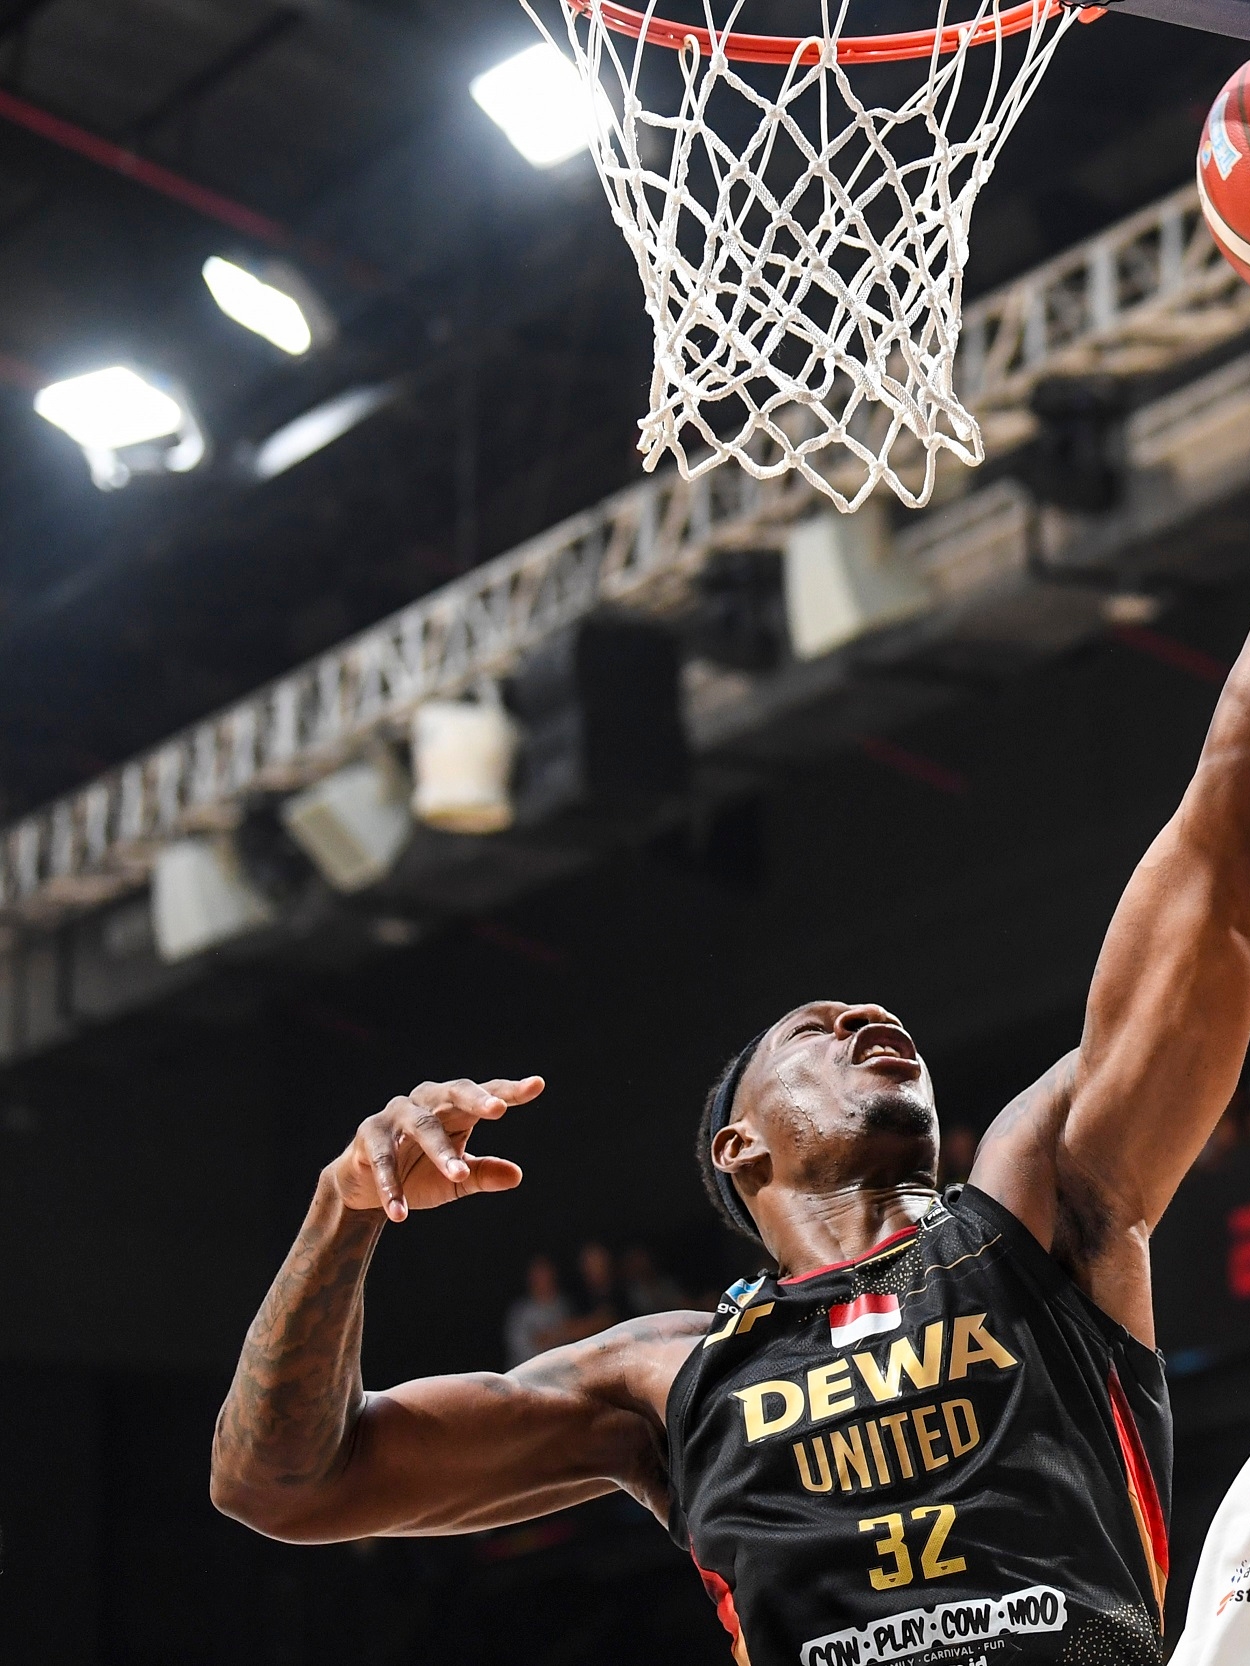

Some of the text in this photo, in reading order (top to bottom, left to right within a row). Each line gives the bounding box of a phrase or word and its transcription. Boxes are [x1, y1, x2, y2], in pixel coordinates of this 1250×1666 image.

[733, 1312, 1019, 1443] DEWA
[793, 1398, 981, 1493] UNITED
[858, 1504, 967, 1591] 32
[872, 1616, 925, 1656] PLAY
[941, 1604, 991, 1640] COW
[1007, 1592, 1058, 1626] MOO
